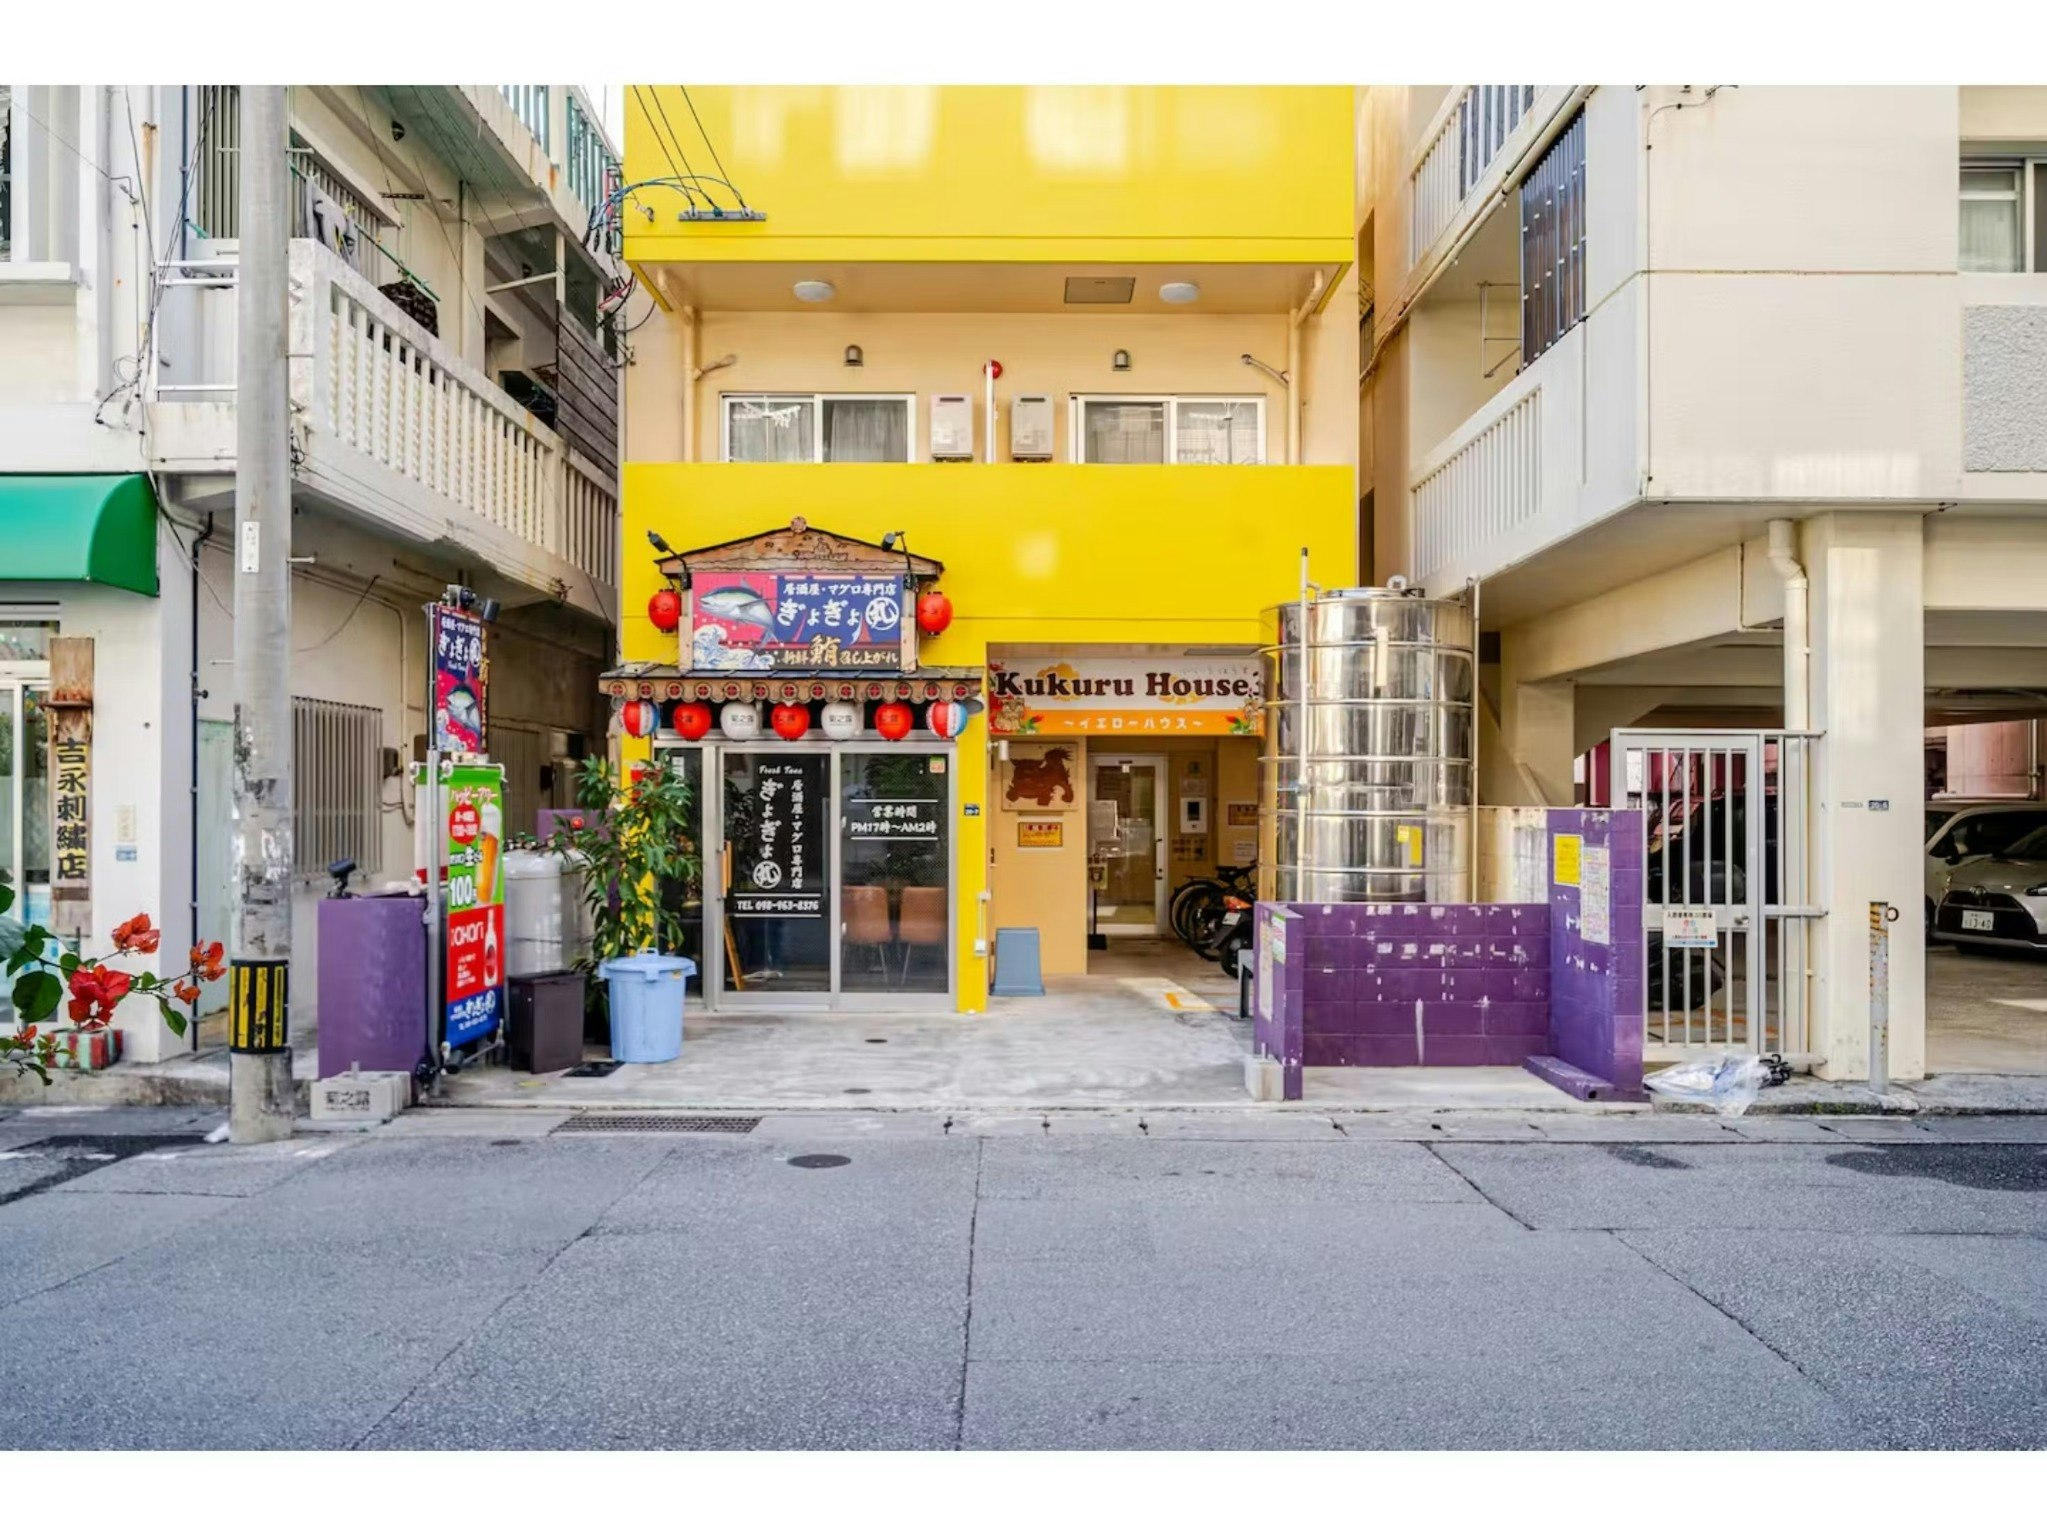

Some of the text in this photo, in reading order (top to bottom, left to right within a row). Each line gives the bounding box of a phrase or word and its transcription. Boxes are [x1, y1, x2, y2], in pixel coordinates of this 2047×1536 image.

[995, 672, 1134, 696] Kukuru
[1146, 673, 1249, 697] House
[56, 738, 86, 879] 吉永刺繍店
